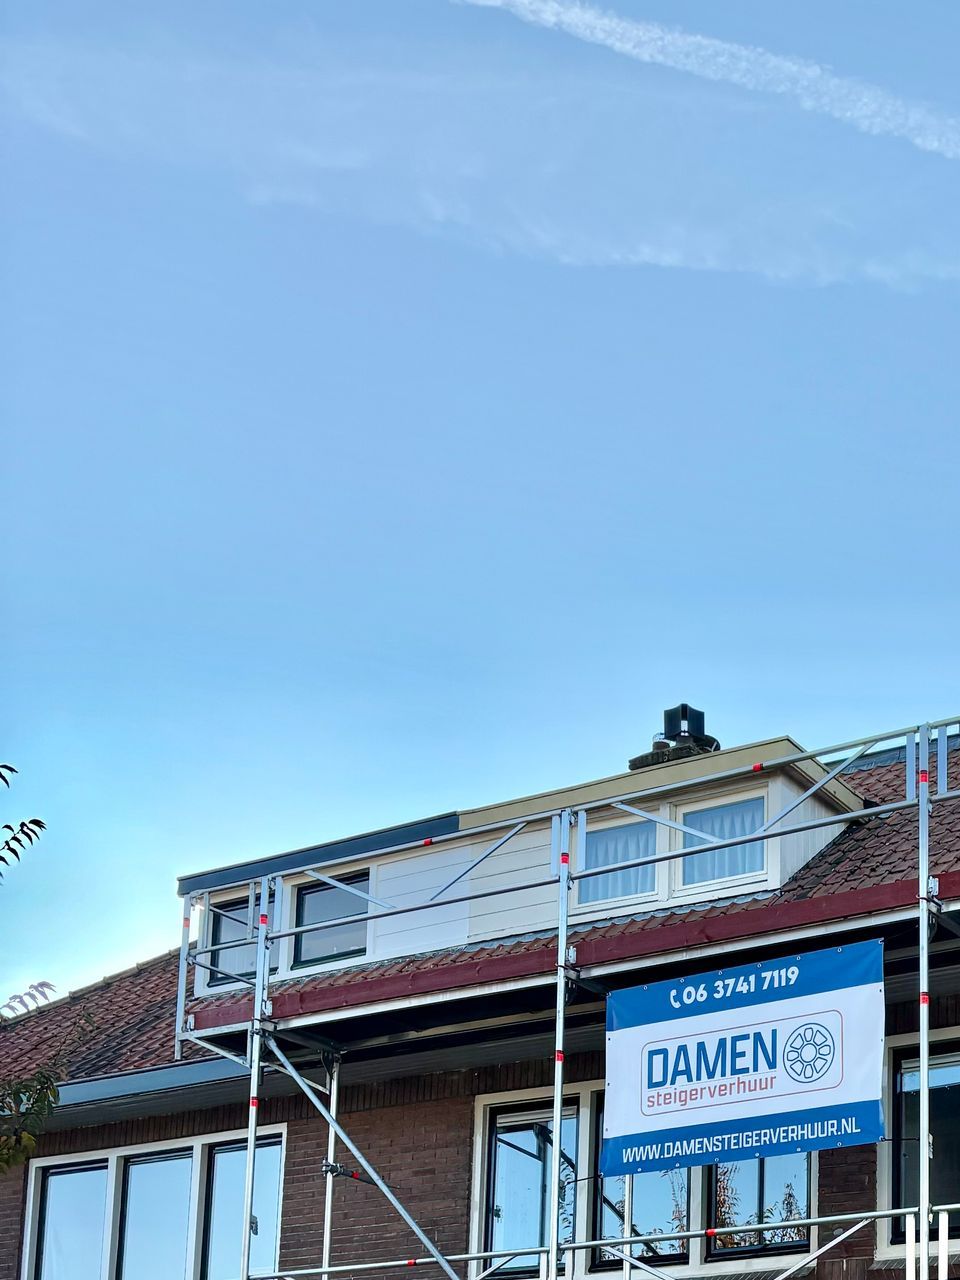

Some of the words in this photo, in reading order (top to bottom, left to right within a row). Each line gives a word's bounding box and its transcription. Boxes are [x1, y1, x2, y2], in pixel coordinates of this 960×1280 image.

[682, 983, 708, 1004] 06
[713, 974, 756, 999] 3741
[761, 966, 800, 991] 7119
[647, 1028, 778, 1090] DAMEN
[646, 1075, 777, 1108] steigerverhuur
[622, 1117, 861, 1163] WWW.DAMENSTEIGERVERHUUR.NL
